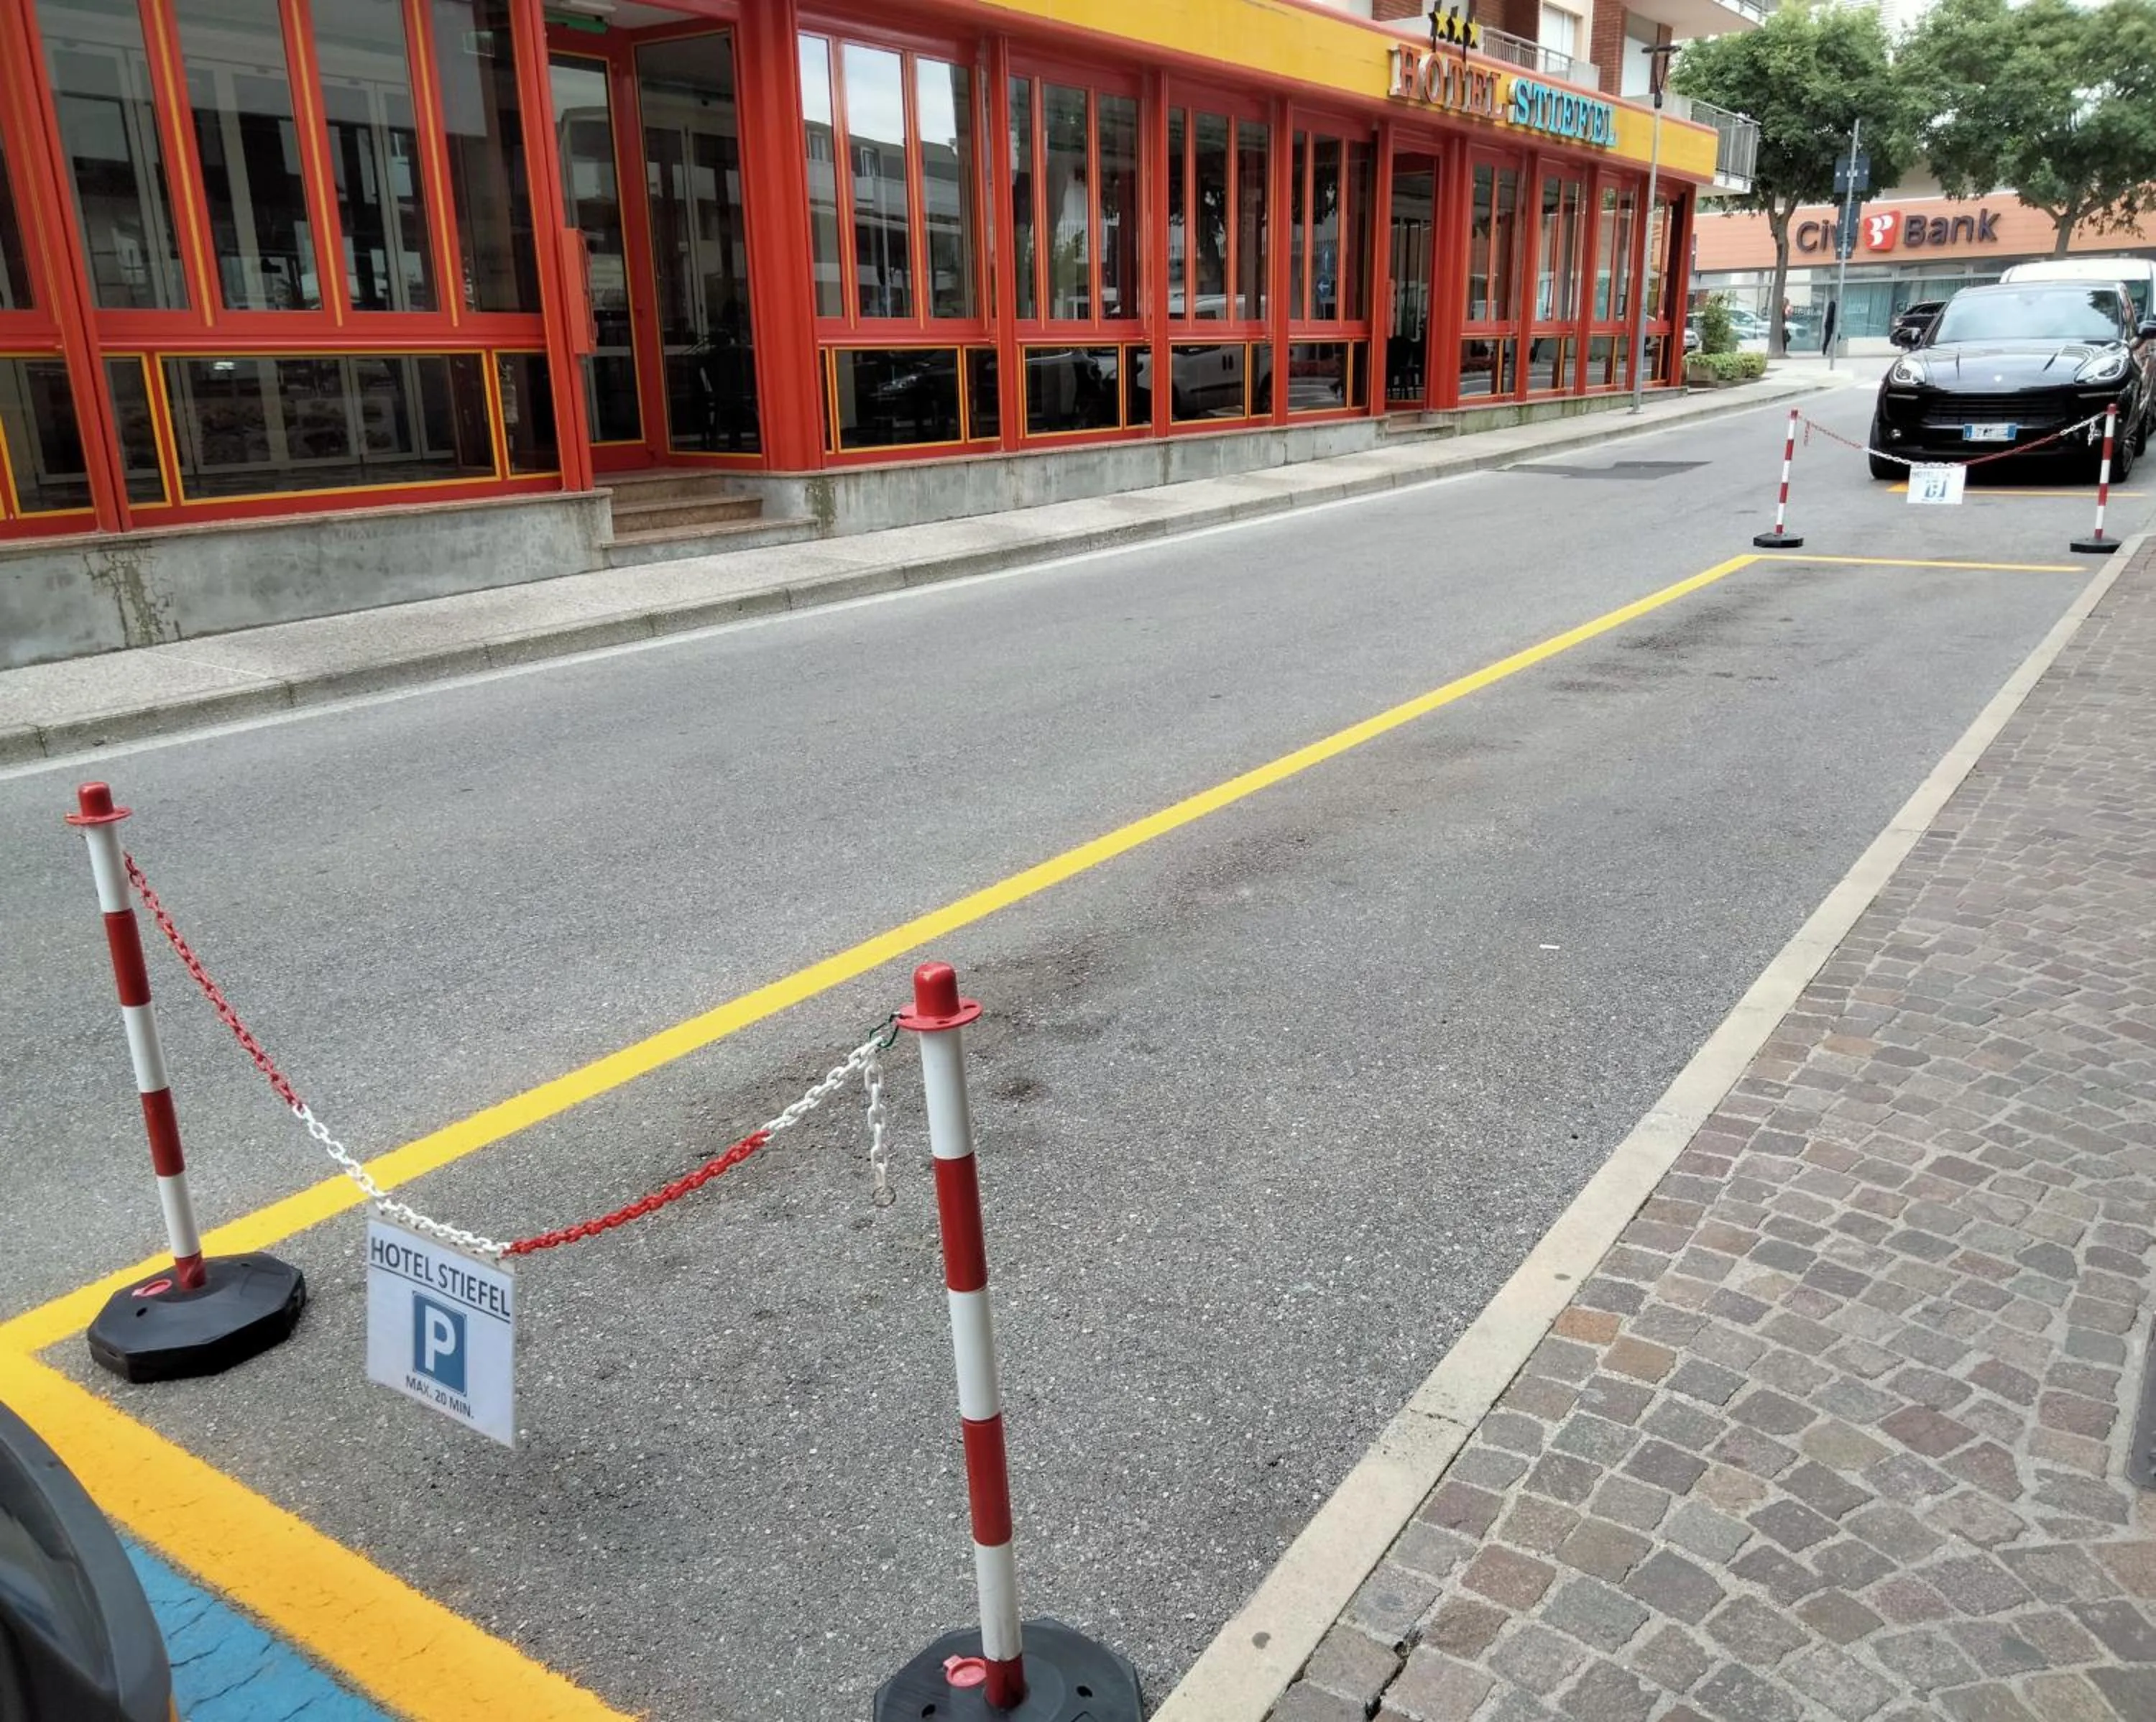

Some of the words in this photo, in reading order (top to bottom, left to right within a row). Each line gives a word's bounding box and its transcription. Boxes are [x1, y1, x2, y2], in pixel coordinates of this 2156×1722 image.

[1388, 43, 1506, 120] HOTEL
[1510, 78, 1617, 147] STIEFEL
[1904, 208, 2001, 247] Bank
[370, 1236, 433, 1284] HOTEL
[438, 1263, 511, 1318] STIEFEL
[425, 1304, 456, 1373] P
[405, 1374, 433, 1399] MAX.
[434, 1389, 447, 1406] 20
[448, 1396, 475, 1420] MIN.
